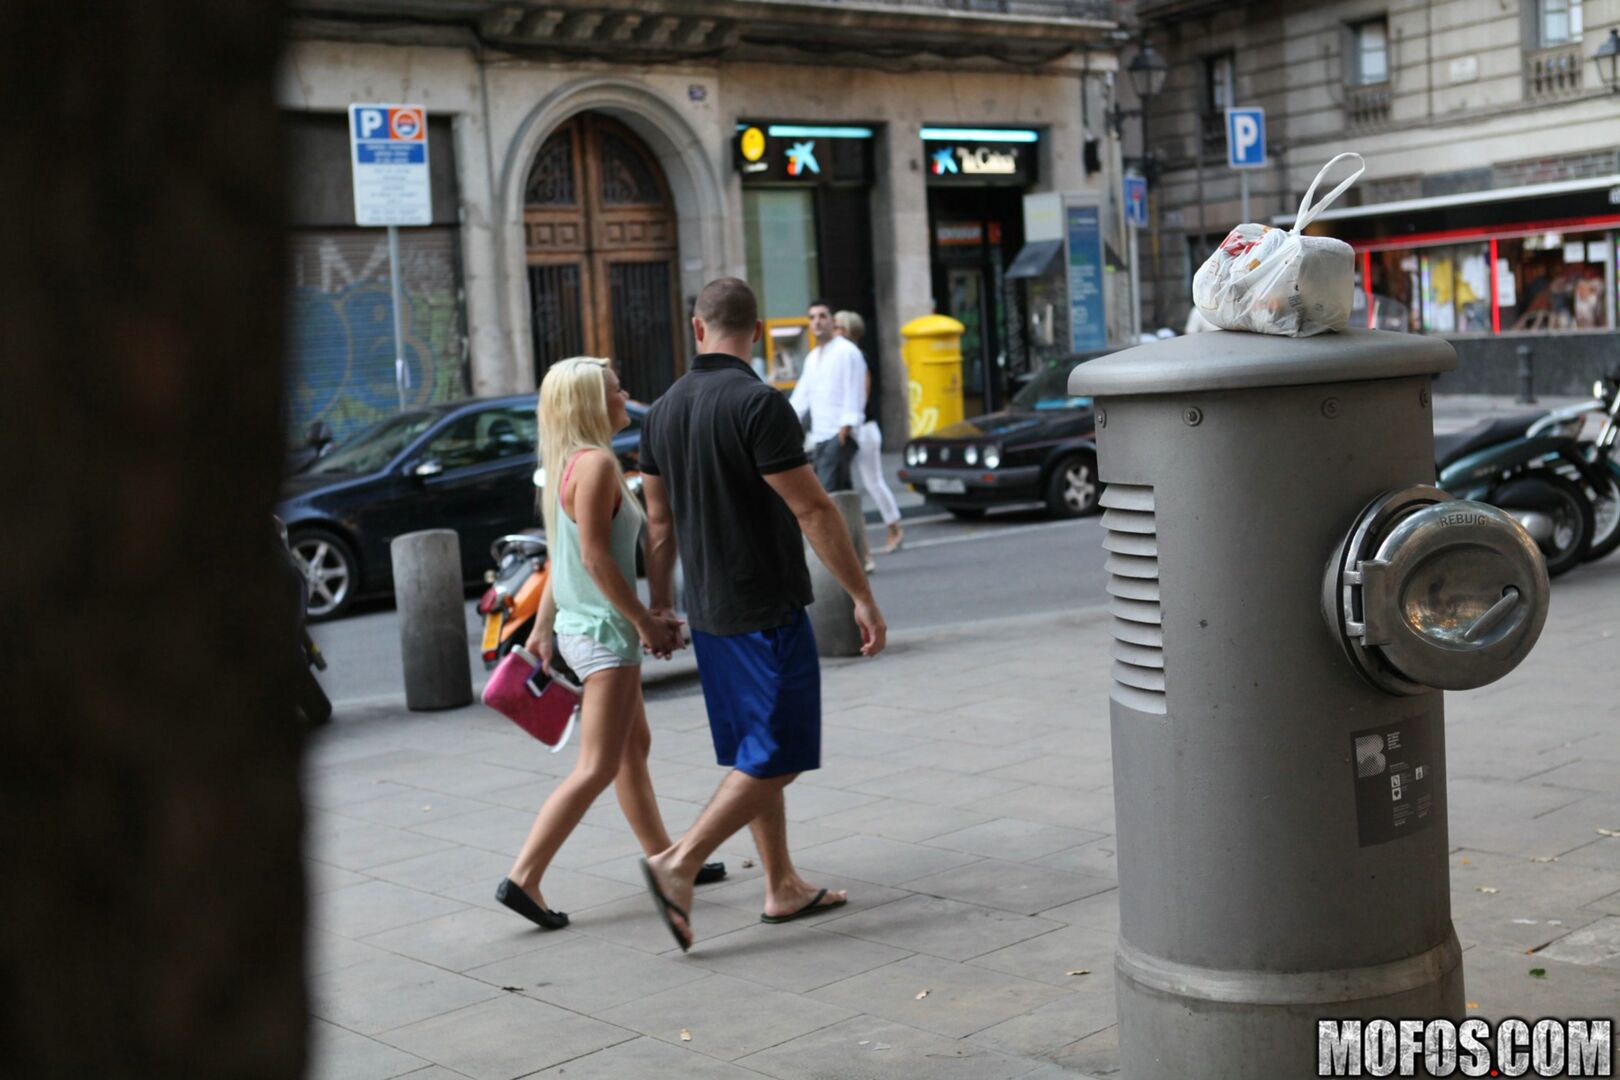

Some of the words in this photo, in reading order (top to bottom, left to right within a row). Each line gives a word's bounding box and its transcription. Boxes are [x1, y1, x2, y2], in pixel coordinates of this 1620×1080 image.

[359, 109, 383, 138] P
[1234, 115, 1258, 161] P
[1439, 512, 1488, 528] REBUIG
[1354, 734, 1386, 779] B
